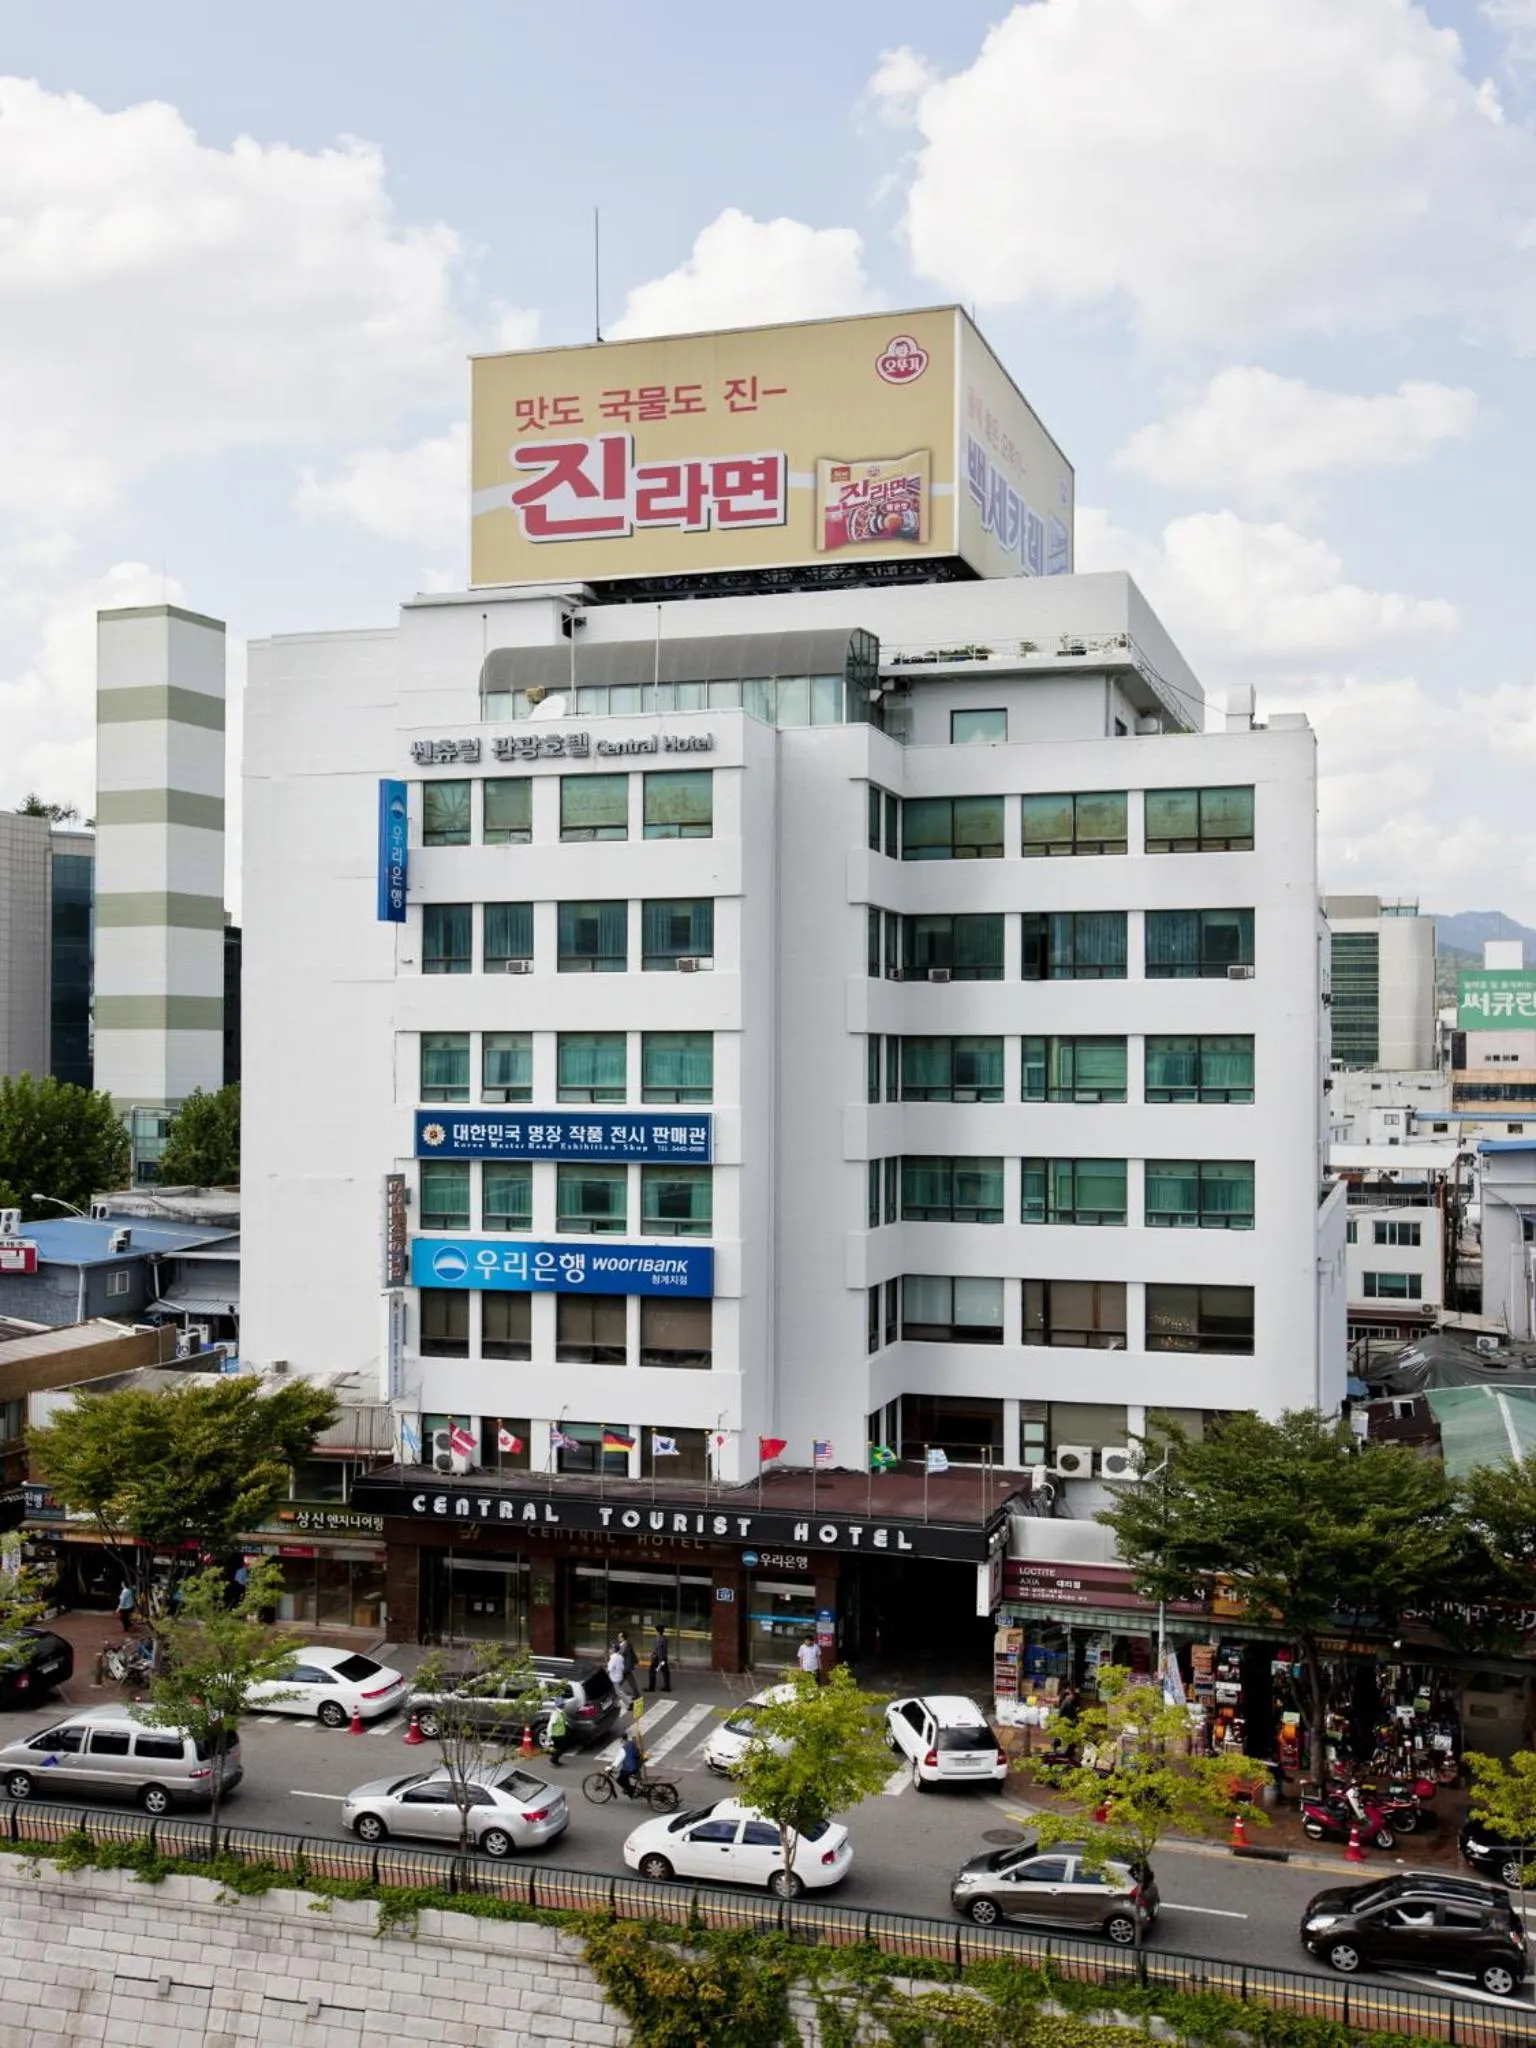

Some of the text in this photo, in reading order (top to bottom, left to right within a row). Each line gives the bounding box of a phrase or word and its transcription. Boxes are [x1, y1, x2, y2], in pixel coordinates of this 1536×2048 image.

[515, 396, 584, 432] 맛도
[599, 384, 706, 423] 국물도
[511, 434, 782, 539] 진라면
[596, 733, 714, 757] Central Hotel
[391, 825, 403, 909] 우리은행
[453, 1124, 706, 1146] 대한민국 명장 작품 전시 판매관
[453, 1141, 484, 1149] Korea
[623, 1144, 648, 1152] Shop
[474, 1250, 586, 1283] 우리은행
[412, 1494, 912, 1550] CENTRAL TOURIST HOTEL
[527, 1526, 705, 1550] CENTRAL HOTEL
[760, 1553, 808, 1570] 우리은행
[1019, 1567, 1056, 1577] LOCTITE
[1020, 1578, 1040, 1586] AXIA
